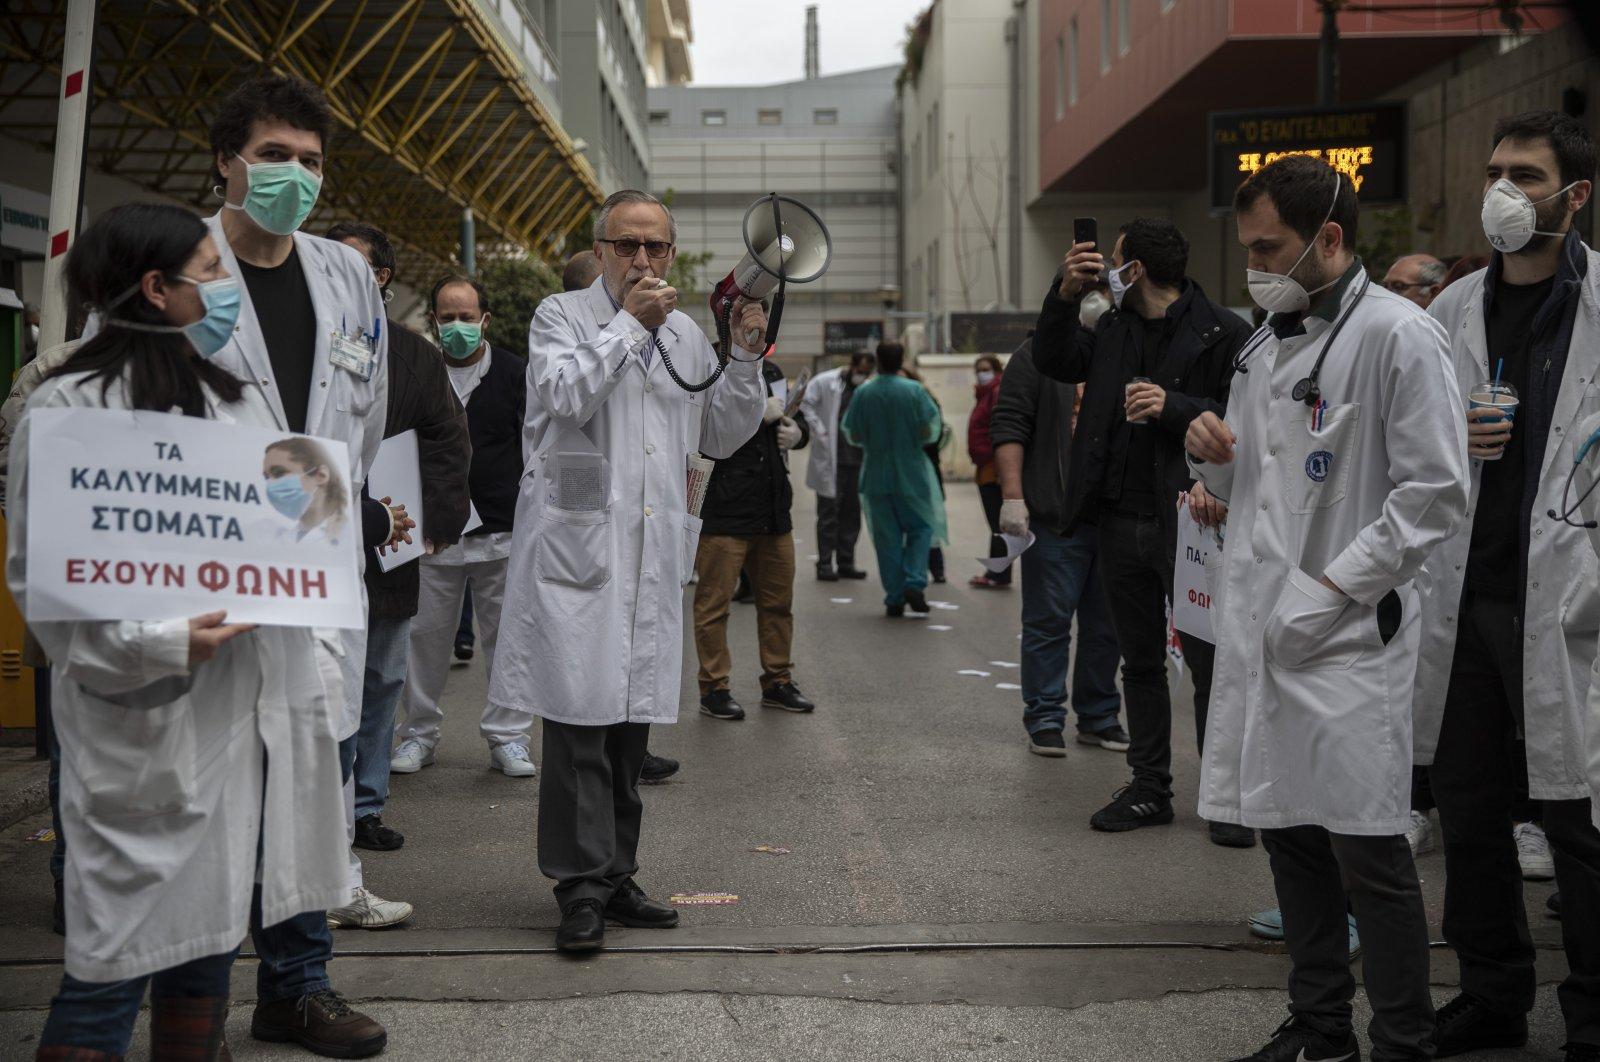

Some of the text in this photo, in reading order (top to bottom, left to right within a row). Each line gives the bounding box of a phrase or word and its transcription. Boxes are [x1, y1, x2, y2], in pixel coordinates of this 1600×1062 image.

[154, 441, 183, 461] ΤΑ
[71, 467, 262, 505] ΚΑΛΥΜΜΕΝΑ
[91, 505, 244, 541] ΣΤΟΜΑΤΑ
[66, 558, 327, 598] ΕΧΟΥΝ ΦΩΝΗ
